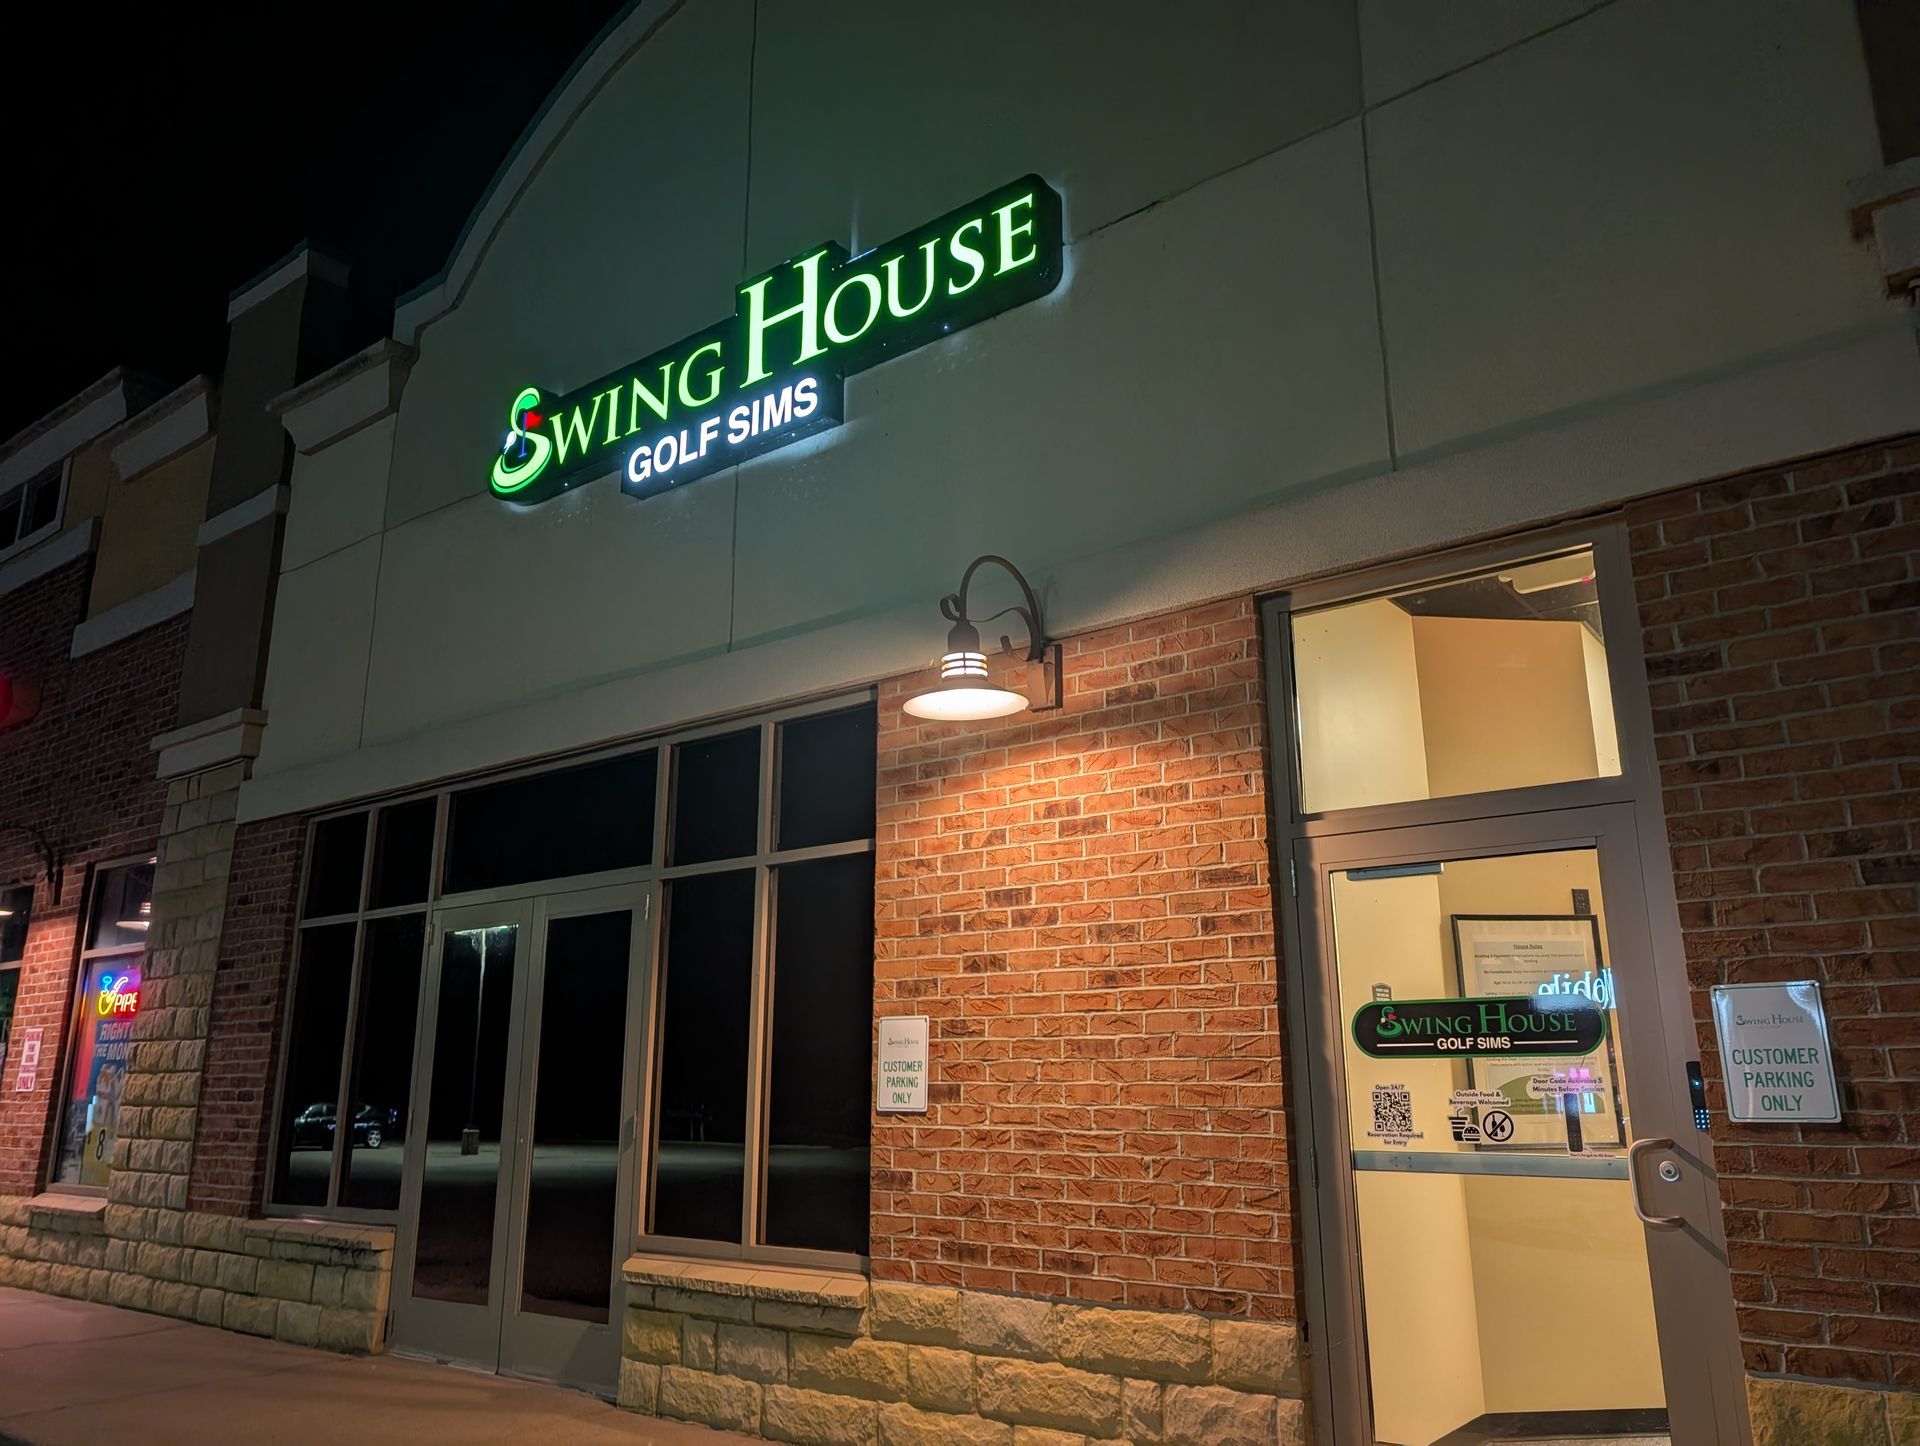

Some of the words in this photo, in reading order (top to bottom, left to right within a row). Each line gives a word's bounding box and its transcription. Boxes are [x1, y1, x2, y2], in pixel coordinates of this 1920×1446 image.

[491, 342, 725, 494] SWING
[740, 194, 1037, 388] HOUSE
[628, 416, 722, 483] GOLF
[728, 377, 818, 445] SIMS
[114, 992, 138, 1013] PIPE
[1376, 1006, 1471, 1037] SWING
[1477, 1004, 1576, 1034] HOUSE
[100, 1022, 131, 1041] RIGHT
[1437, 1038, 1474, 1050] GOLF
[1477, 1037, 1511, 1049] SIMS
[1732, 1048, 1819, 1065] CUSTOMER
[883, 1061, 923, 1073] CUSTOMER
[886, 1077, 919, 1088] PARKING
[1375, 1084, 1390, 1092] Open
[1744, 1071, 1815, 1088] PARKING
[892, 1092, 912, 1104] ONLY
[1478, 1098, 1510, 1106] Welcomed
[1761, 1095, 1803, 1112] ONLY
